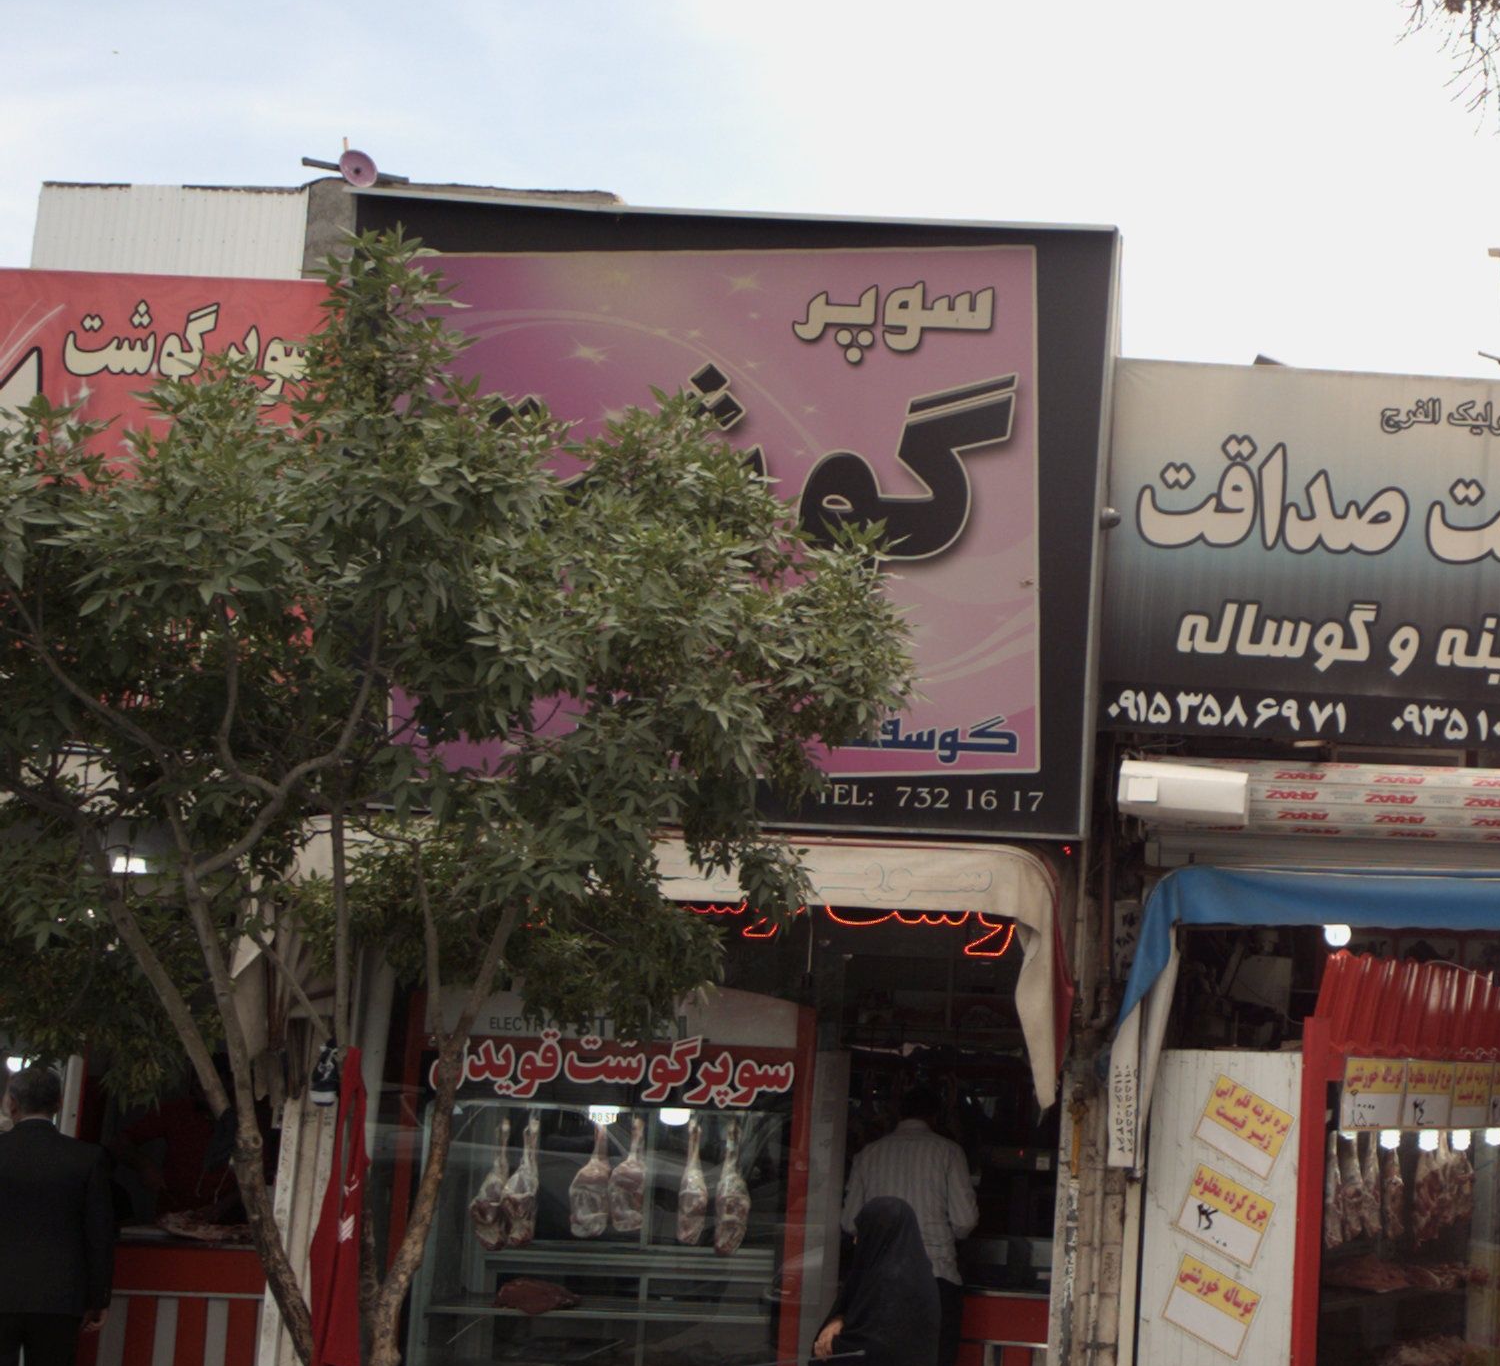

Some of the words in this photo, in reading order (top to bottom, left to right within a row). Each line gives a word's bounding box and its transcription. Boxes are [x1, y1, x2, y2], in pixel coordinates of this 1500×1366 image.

[63, 299, 220, 385] گوشت
[793, 281, 995, 365] سوپر
[1135, 434, 1411, 556] صداقت
[1175, 601, 1380, 674] گوساله
[1387, 623, 1421, 677] و
[820, 784, 874, 807] TEL:
[896, 786, 950, 809] 732
[966, 789, 998, 811] 16
[1012, 790, 1044, 812] 17
[563, 1035, 702, 1103] گوشت
[683, 1051, 795, 1108] سوپر
